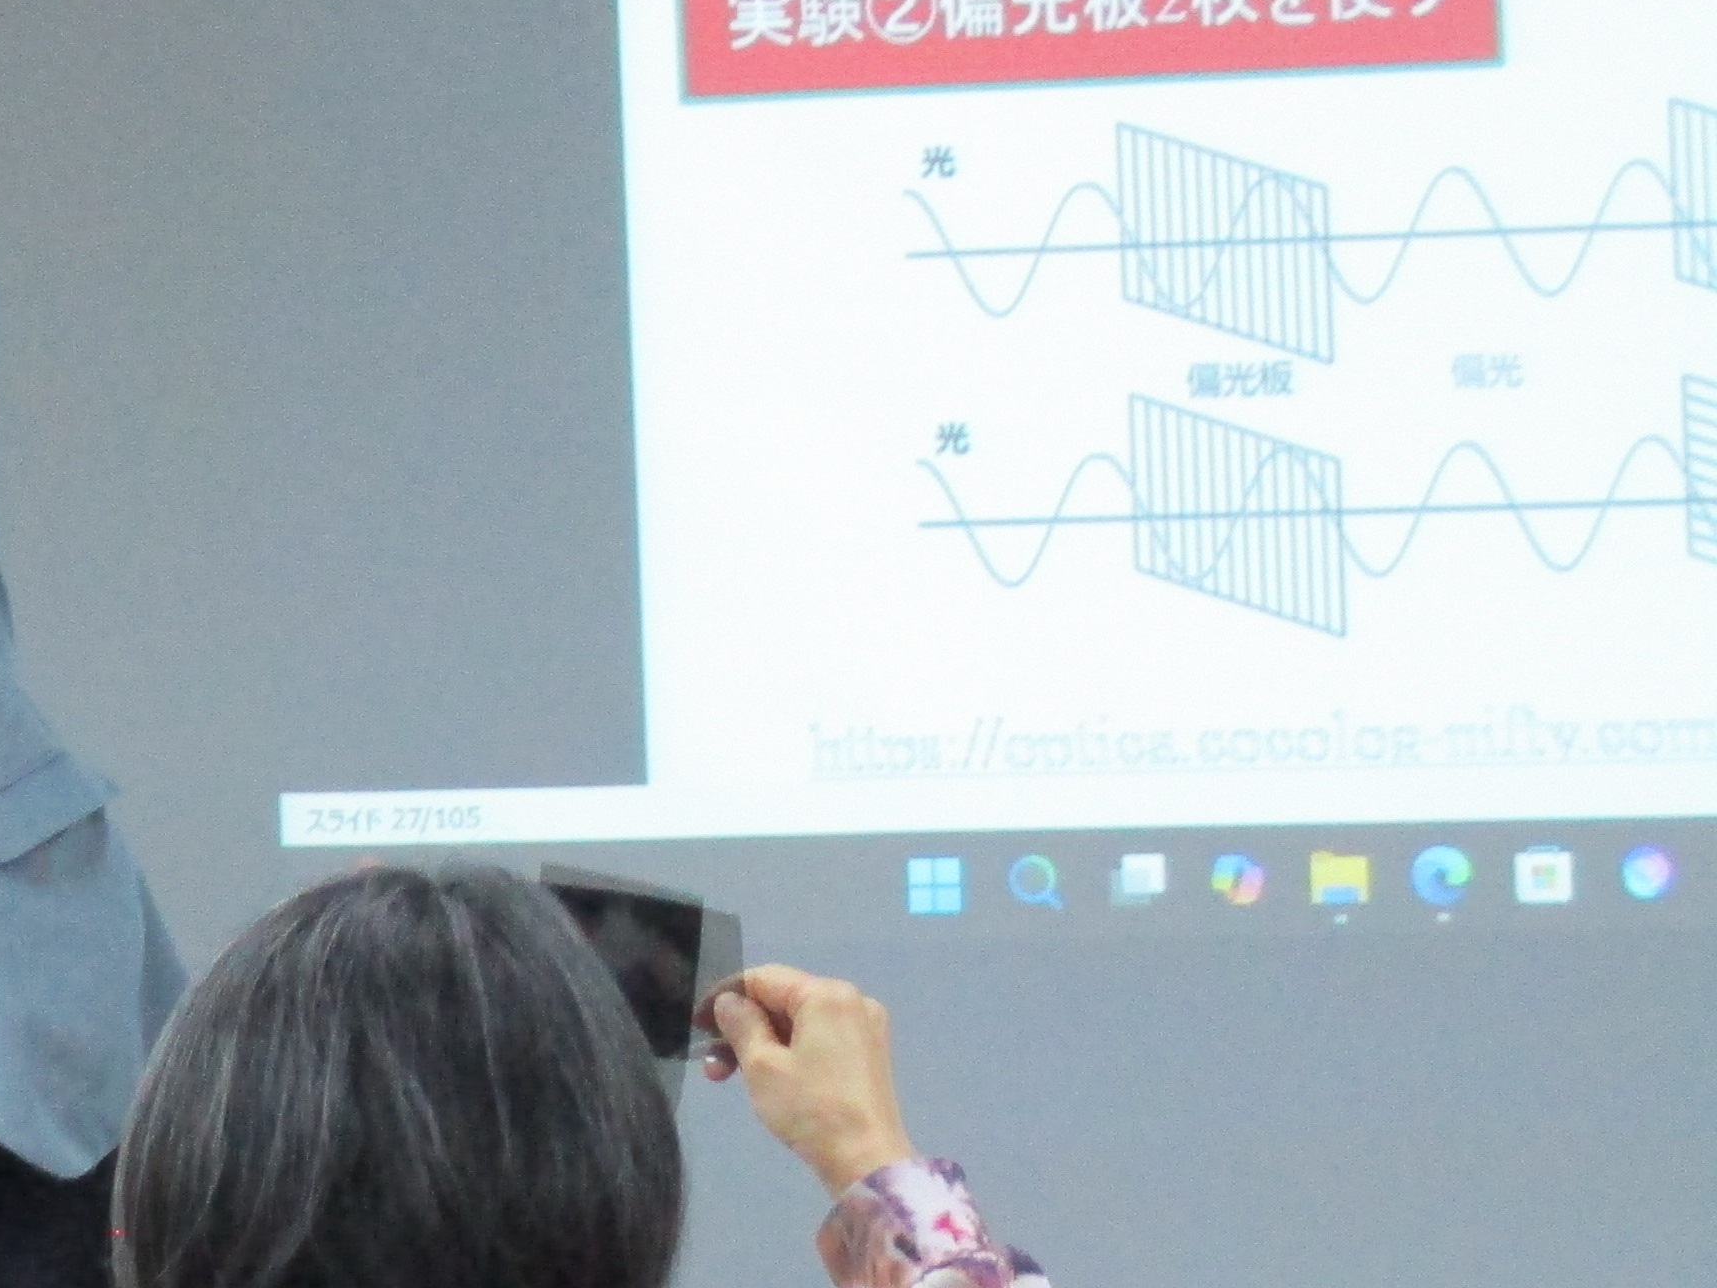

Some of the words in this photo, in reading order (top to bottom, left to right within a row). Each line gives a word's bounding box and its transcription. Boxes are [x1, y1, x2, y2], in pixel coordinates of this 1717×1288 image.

[921, 144, 957, 178] 光
[1186, 360, 1294, 399] 偏光板
[1452, 352, 1525, 390] 偏光
[935, 421, 970, 456] 光
[305, 807, 382, 834] スライド
[391, 805, 482, 834] 27/105
